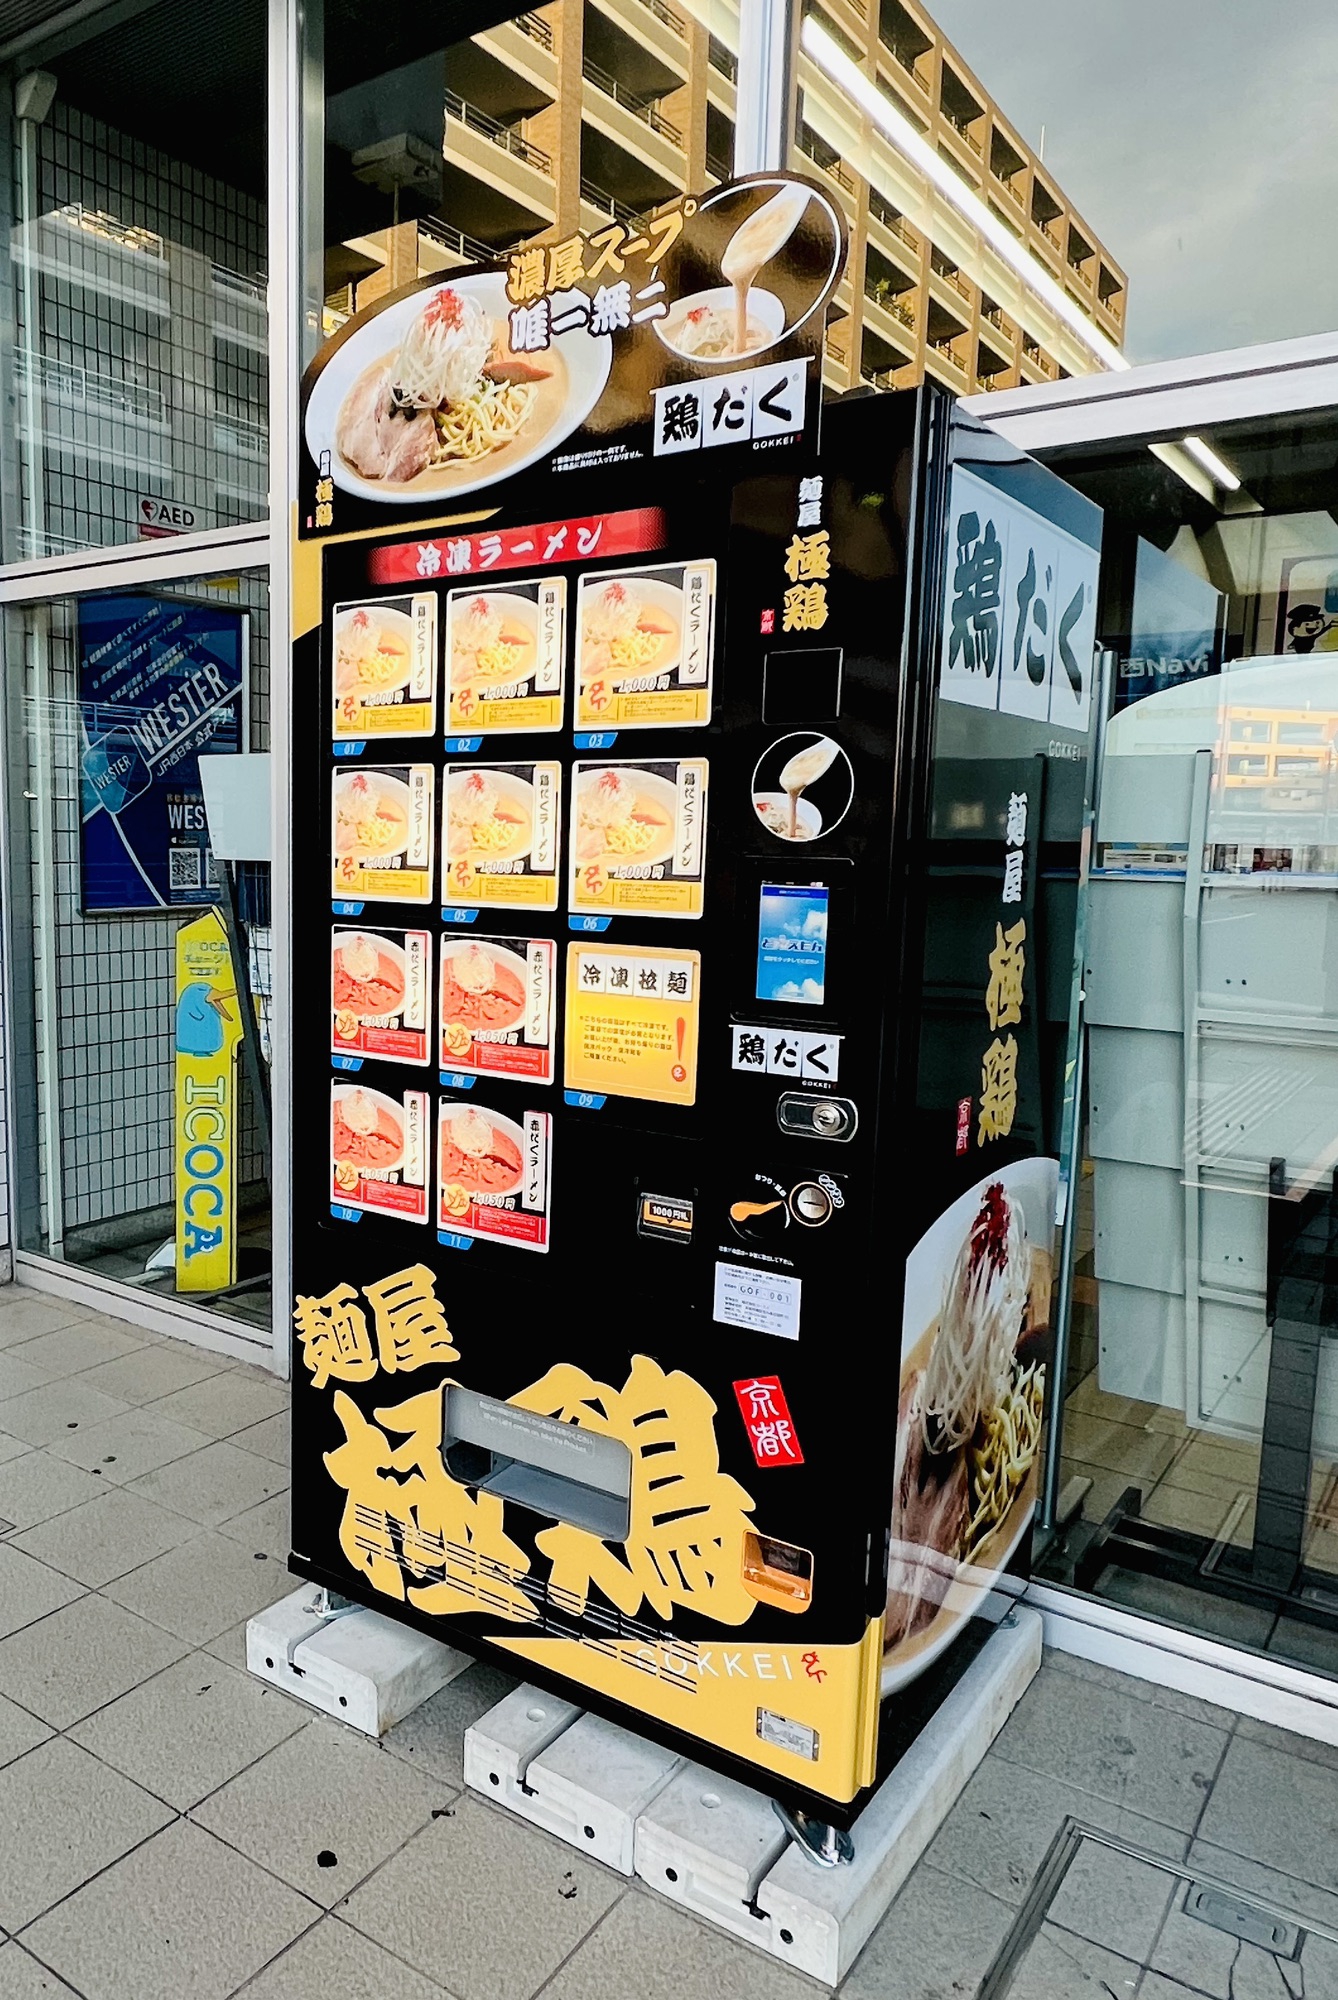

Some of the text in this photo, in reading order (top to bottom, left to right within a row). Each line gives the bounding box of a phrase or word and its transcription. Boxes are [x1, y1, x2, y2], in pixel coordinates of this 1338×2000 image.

[510, 199, 697, 303] 濃厚スープ
[510, 281, 668, 352] 唯一無二
[662, 377, 791, 443] 鶏だく
[752, 435, 793, 450] GOKKEI
[159, 504, 195, 527] AED
[415, 521, 605, 577] 冷凍ラーメン
[782, 476, 832, 633] 麺屋 極鶏
[948, 510, 1085, 705] 鶏だく
[133, 662, 229, 755] WESTER
[343, 743, 357, 755] 01
[457, 739, 470, 751] 02
[588, 735, 603, 748] 03
[94, 755, 132, 791] WESTER
[343, 902, 354, 914] 04
[454, 908, 467, 921] 05
[583, 917, 597, 930] 06
[411, 941, 420, 1022] 赤だくラーメン
[532, 951, 543, 1036] 赤だくラーメン
[978, 791, 1027, 1148] 麺屋 極鶏
[342, 1057, 353, 1069] 07
[451, 1073, 464, 1087] 08
[737, 1033, 834, 1075] 鶏だく
[578, 1094, 593, 1107] 09
[409, 1098, 418, 1177] 赤だくラーメン
[530, 1119, 540, 1203] 赤だくラーメン
[184, 1075, 224, 1260] ICOCA
[293, 1263, 461, 1388] 麺屋
[741, 1381, 798, 1459] 京都
[635, 1646, 794, 1682] GOKKEI
